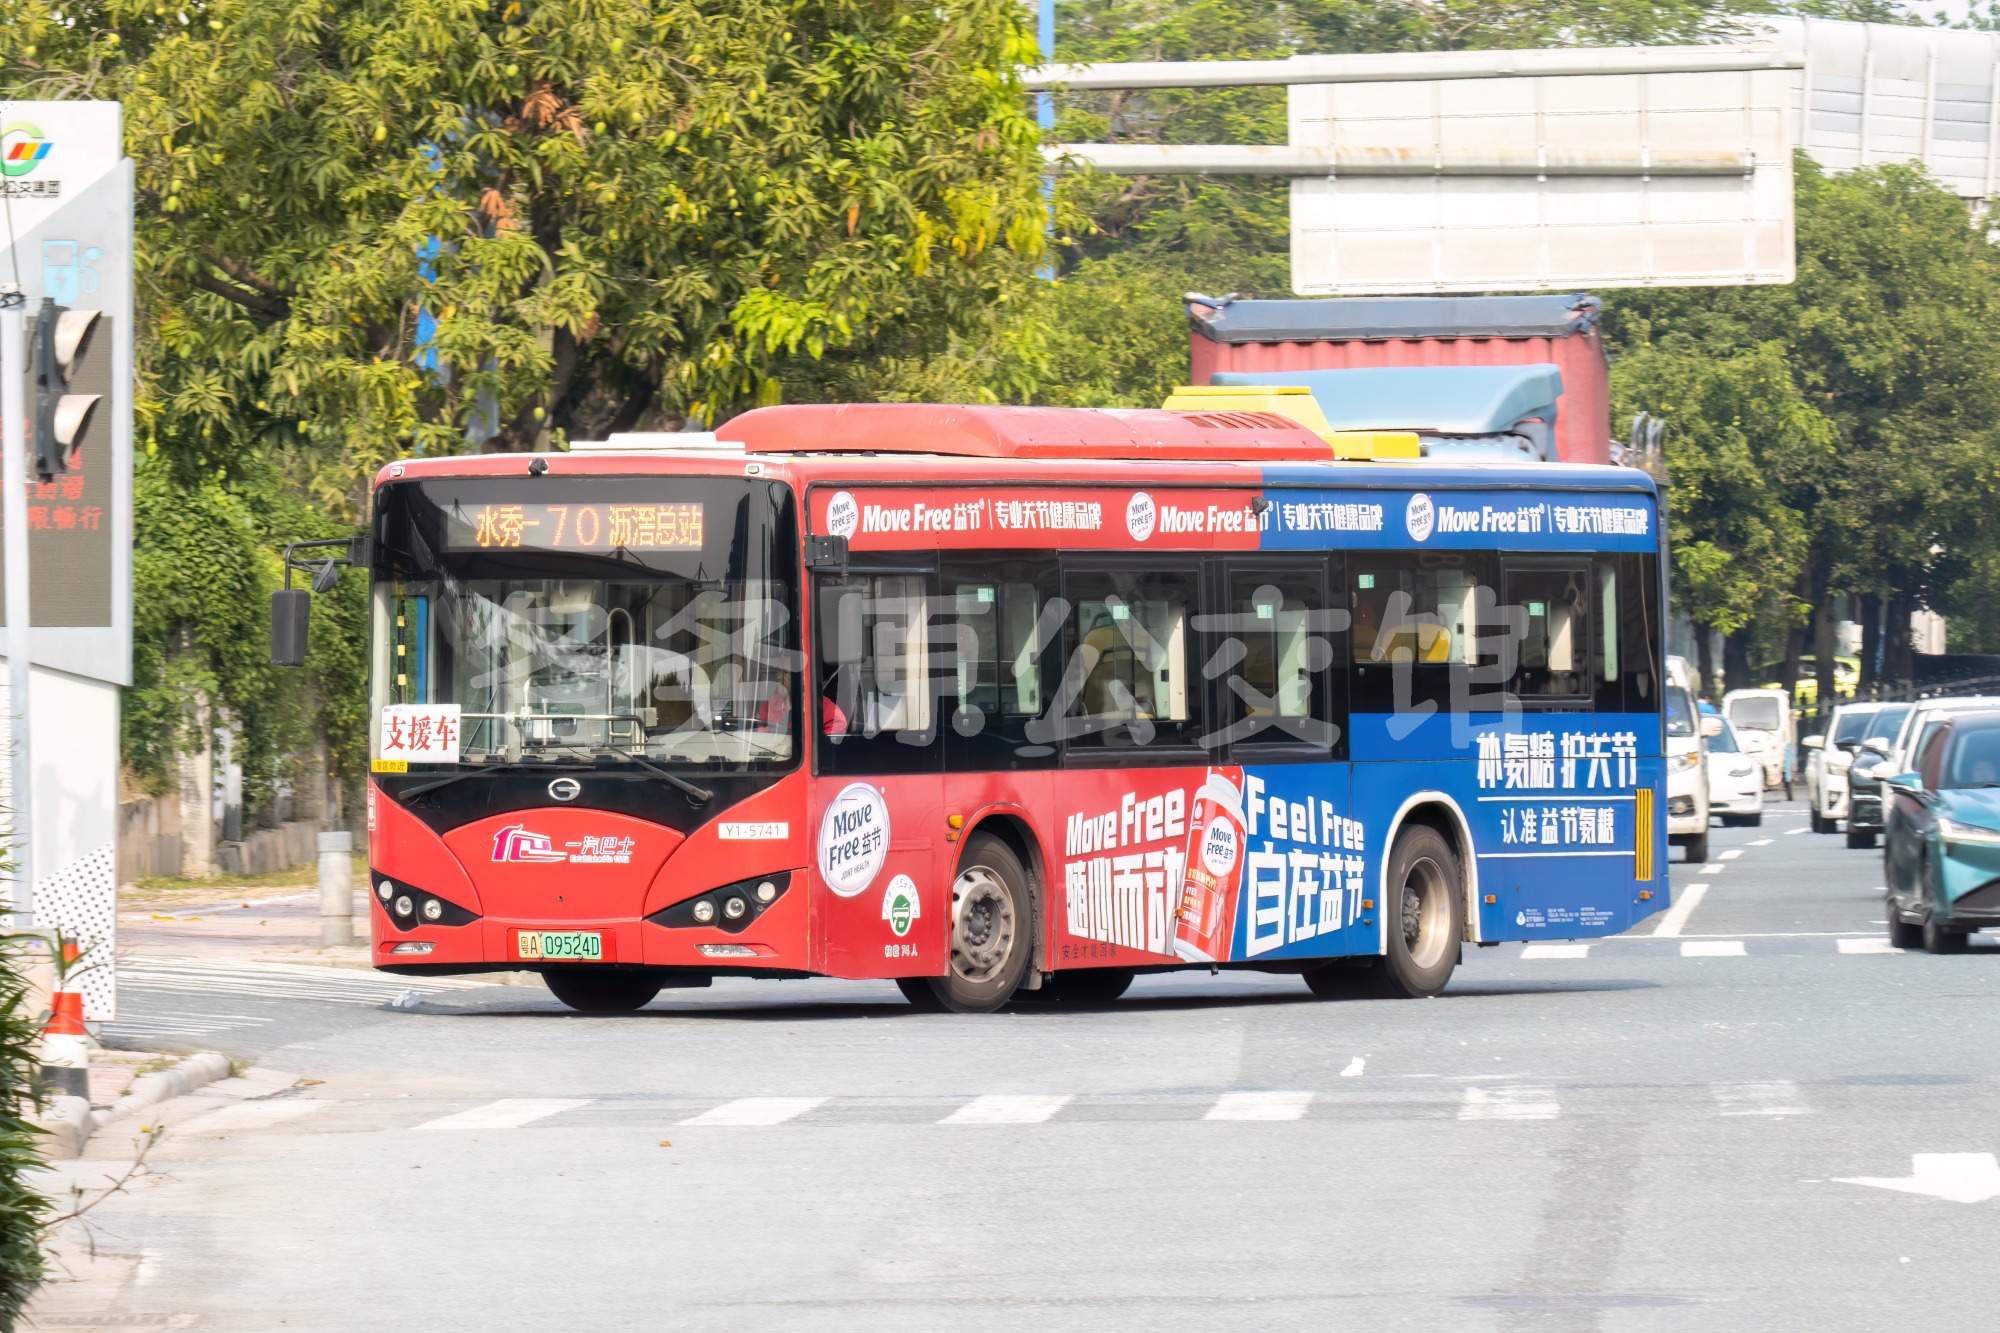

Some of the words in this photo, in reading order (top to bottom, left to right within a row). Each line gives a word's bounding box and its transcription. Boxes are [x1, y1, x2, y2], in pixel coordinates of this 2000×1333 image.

[0, 180, 61, 194] 公交集团
[547, 506, 600, 547] 70
[608, 504, 704, 547] 沥滘总站
[862, 504, 910, 533] Move
[913, 503, 951, 531] Free
[954, 503, 980, 531] 益节
[995, 500, 1103, 530] 专业关节健康品牌
[1159, 505, 1204, 533] Move
[1207, 505, 1242, 532] Free
[1283, 503, 1383, 531] 专业关节健康品牌
[1437, 506, 1479, 533] Move
[1482, 505, 1517, 533] Free
[1518, 506, 1541, 533] 益节
[1553, 506, 1649, 534] 专业关节健康品牌
[383, 715, 457, 751] 支援车
[376, 761, 405, 771] 区勿近
[1476, 731, 1555, 789] 补氨糖
[1560, 731, 1637, 788] 护关节
[833, 803, 872, 840] Move
[1066, 811, 1117, 857] Move
[1121, 788, 1185, 847] Free
[1246, 774, 1316, 844] Feel
[1321, 800, 1365, 851] Free
[565, 836, 635, 855] 一汽巴士
[726, 825, 779, 837] Y1-5741
[1211, 827, 1231, 844] Move
[829, 836, 859, 871] Free
[861, 826, 881, 856] 益节
[1206, 842, 1224, 856] Free
[854, 860, 870, 872] HEALTH
[1246, 841, 1365, 958] 自在益节
